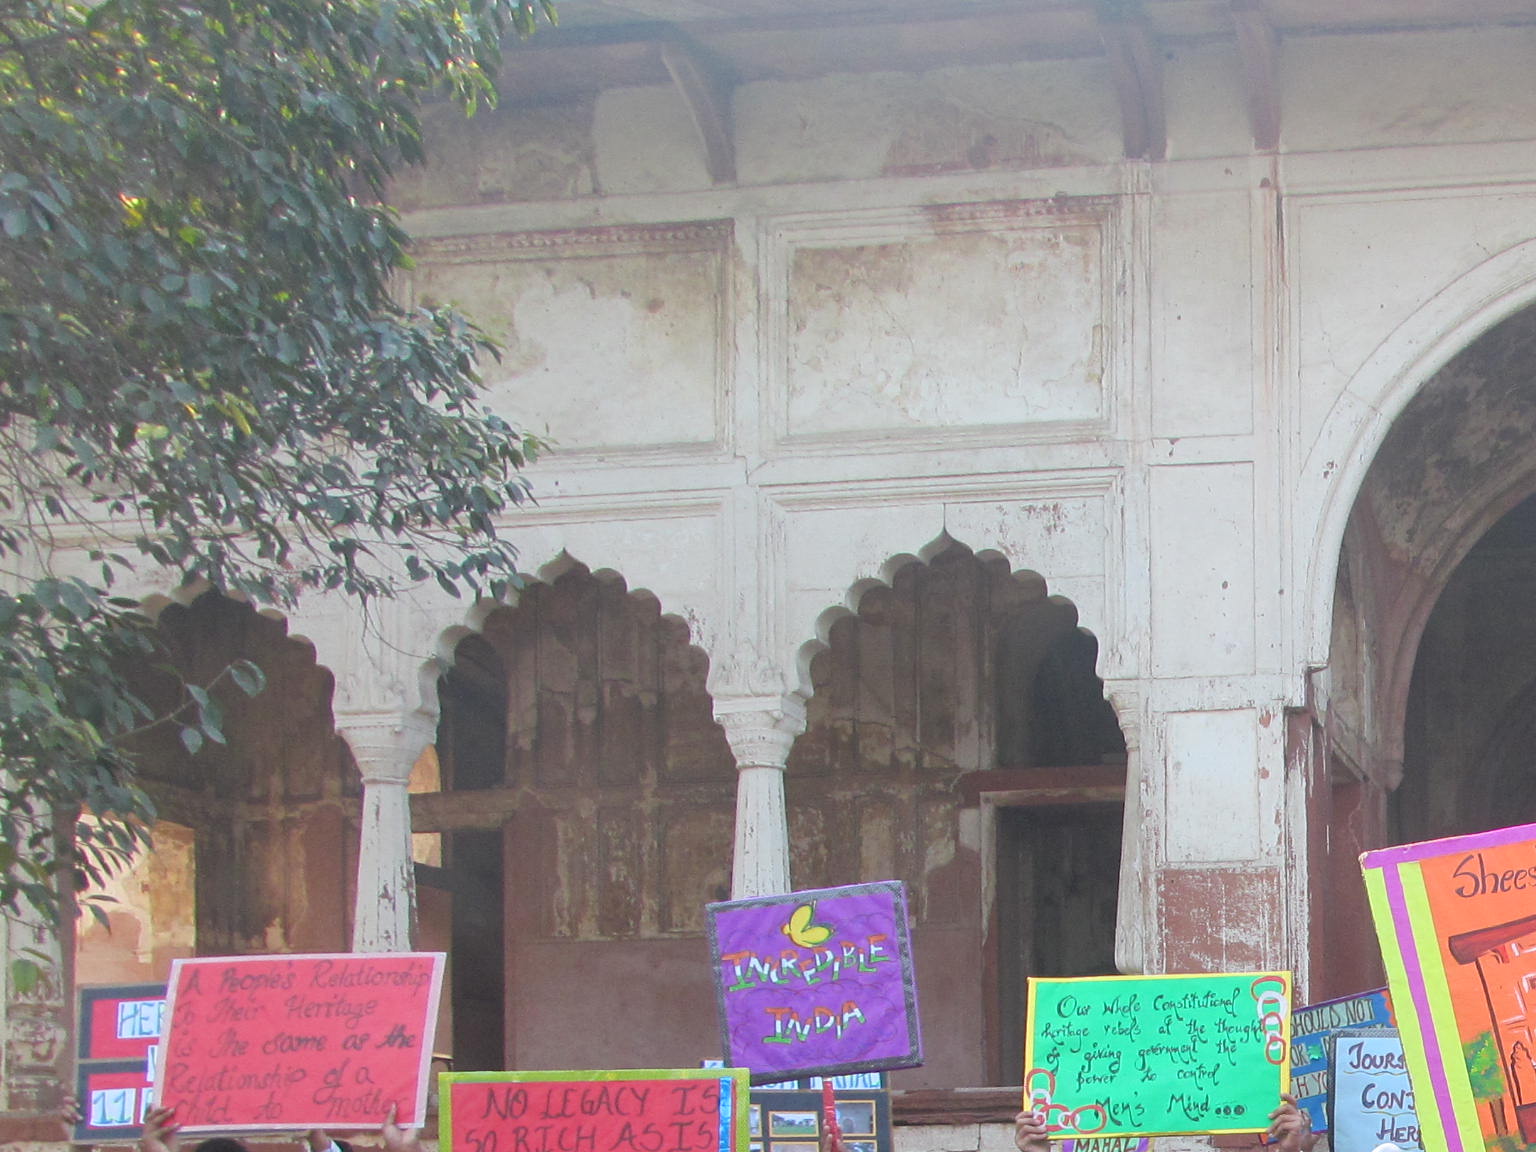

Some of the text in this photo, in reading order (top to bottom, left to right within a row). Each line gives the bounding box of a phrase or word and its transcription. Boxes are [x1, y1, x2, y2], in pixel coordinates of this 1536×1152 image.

[182, 967, 203, 996] A
[310, 959, 430, 997] Relationship
[722, 933, 891, 991] INCREDIBLE
[283, 996, 377, 1029] Heritage
[1057, 994, 1091, 1018] Our
[1153, 987, 1240, 1021] Constitutional
[1345, 999, 1374, 1026] NOT
[375, 1023, 415, 1049] the
[762, 1001, 866, 1044] INDIA
[1041, 1022, 1089, 1053] heritage
[1104, 1018, 1142, 1043] rebels
[1186, 1020, 1208, 1043] the
[1215, 1018, 1264, 1043] thought
[1216, 1039, 1237, 1066] the
[170, 1062, 307, 1096] Relationship
[1177, 1063, 1221, 1091] control
[93, 1090, 132, 1124] 11
[482, 1085, 720, 1119] NO LEGACY IS
[1094, 1092, 1145, 1127] Men's
[1376, 1118, 1421, 1143] HER
